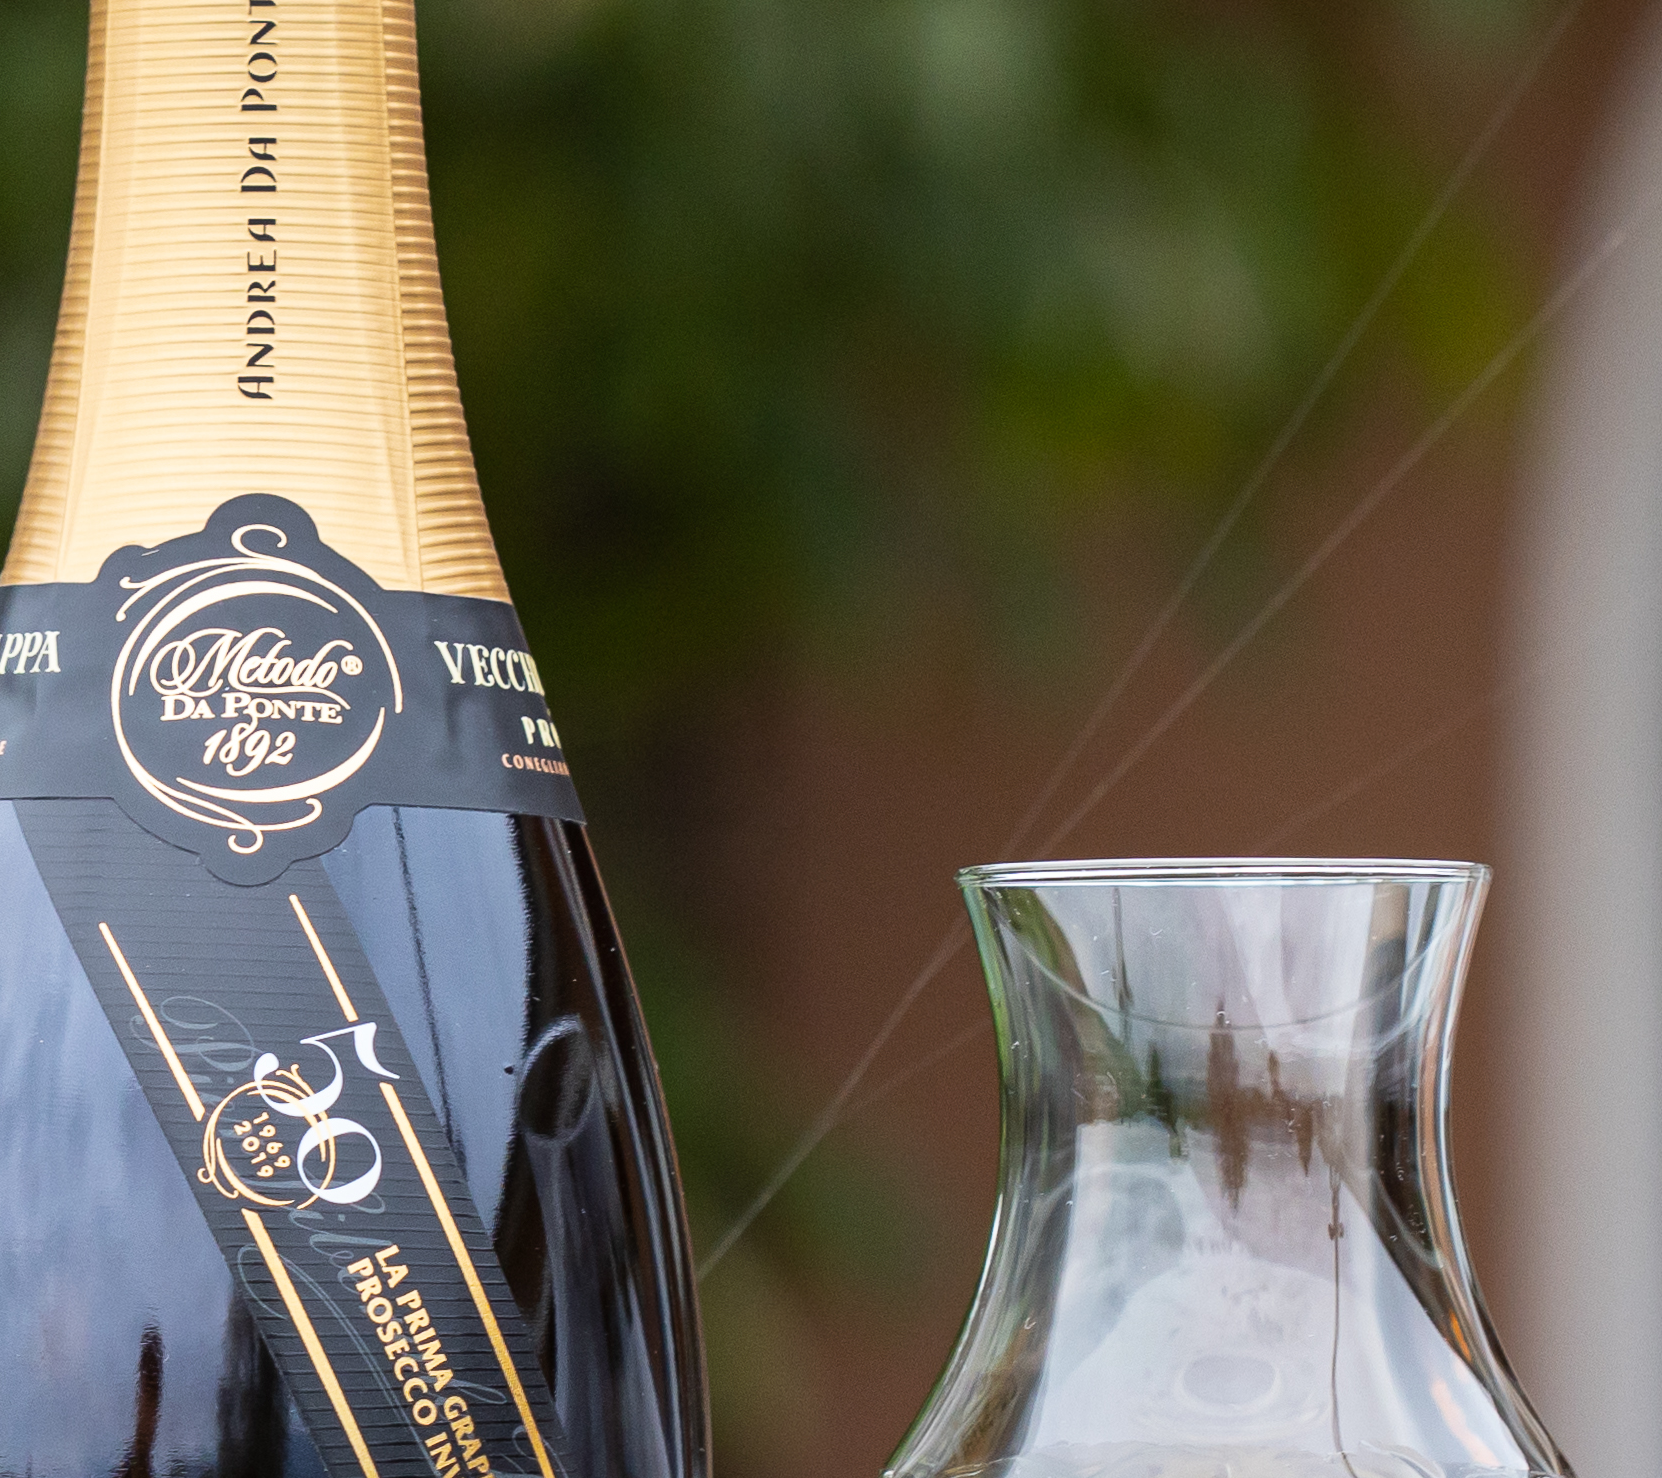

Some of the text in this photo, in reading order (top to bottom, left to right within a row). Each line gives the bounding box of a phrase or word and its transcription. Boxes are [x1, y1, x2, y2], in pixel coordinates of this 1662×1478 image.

[240, 137, 277, 193] DA
[237, 219, 276, 399] ANDREA
[202, 722, 297, 778] 1892
[233, 1120, 274, 1177] 2019
[253, 1112, 291, 1168] 1969
[254, 1022, 400, 1204] 50
[347, 1257, 437, 1426] PROSECCO
[375, 1244, 408, 1289] LA
[396, 1290, 453, 1391] PRIMA
